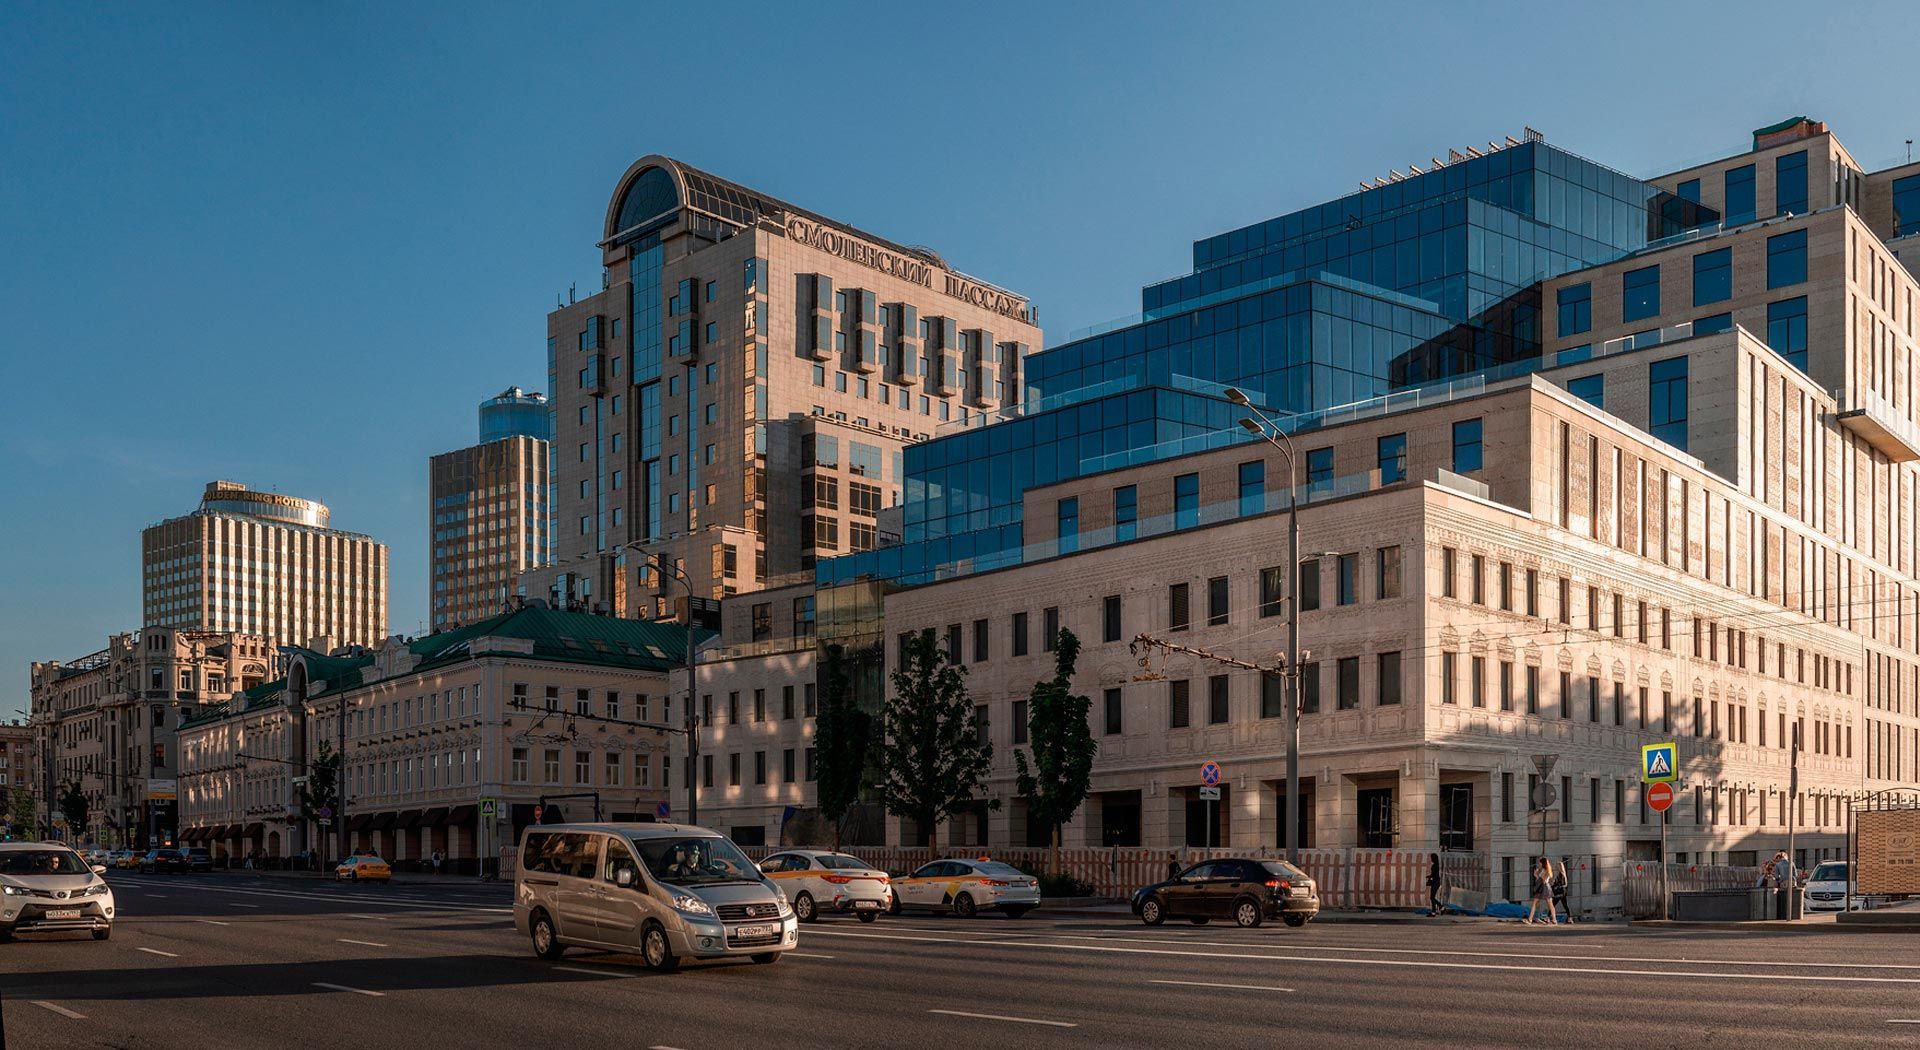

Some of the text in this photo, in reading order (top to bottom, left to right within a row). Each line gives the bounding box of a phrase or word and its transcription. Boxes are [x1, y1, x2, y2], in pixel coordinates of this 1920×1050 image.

[787, 216, 1021, 317] СМОЛЕНСКИЙ ПАССАЖ
[243, 493, 271, 503] RING
[275, 495, 305, 508] HOTEL
